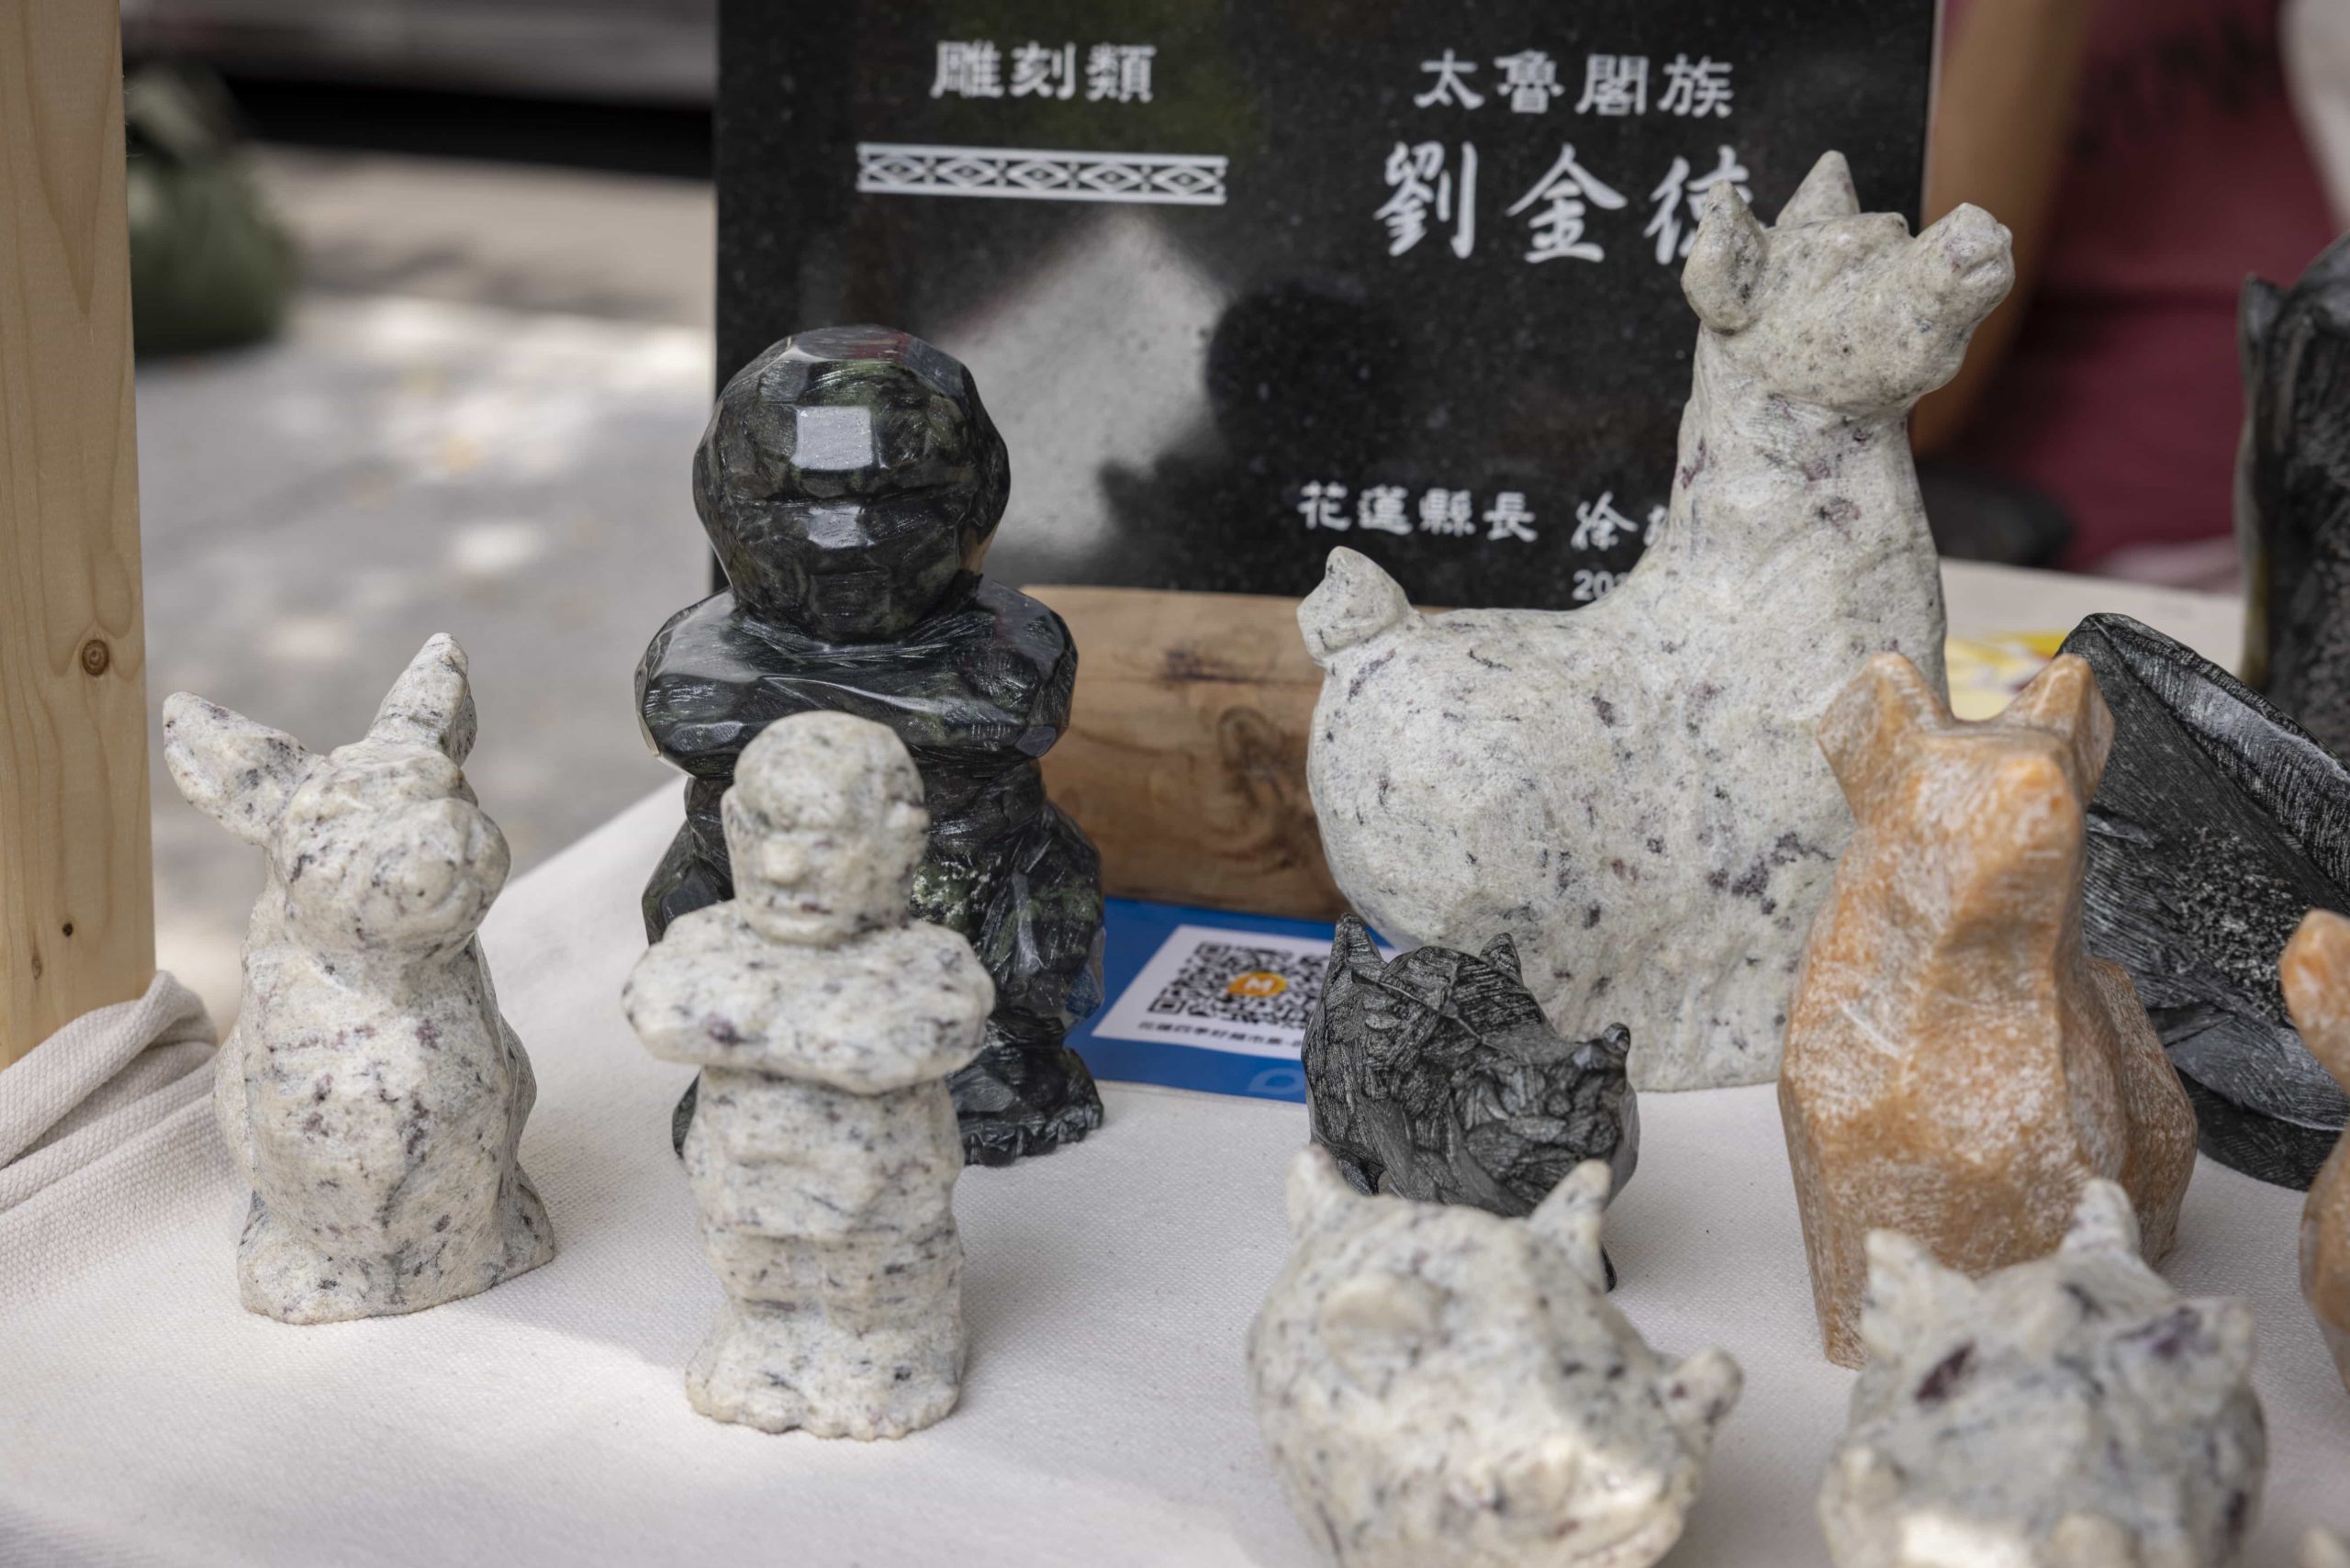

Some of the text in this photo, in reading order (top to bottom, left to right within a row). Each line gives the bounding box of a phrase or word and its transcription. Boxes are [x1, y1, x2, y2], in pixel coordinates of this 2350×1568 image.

[929, 39, 1157, 103] 雕刻類
[1414, 48, 1734, 118] 太魯閣族
[1296, 479, 1539, 543] 花蓮縣長
[1572, 569, 1630, 601] 20
